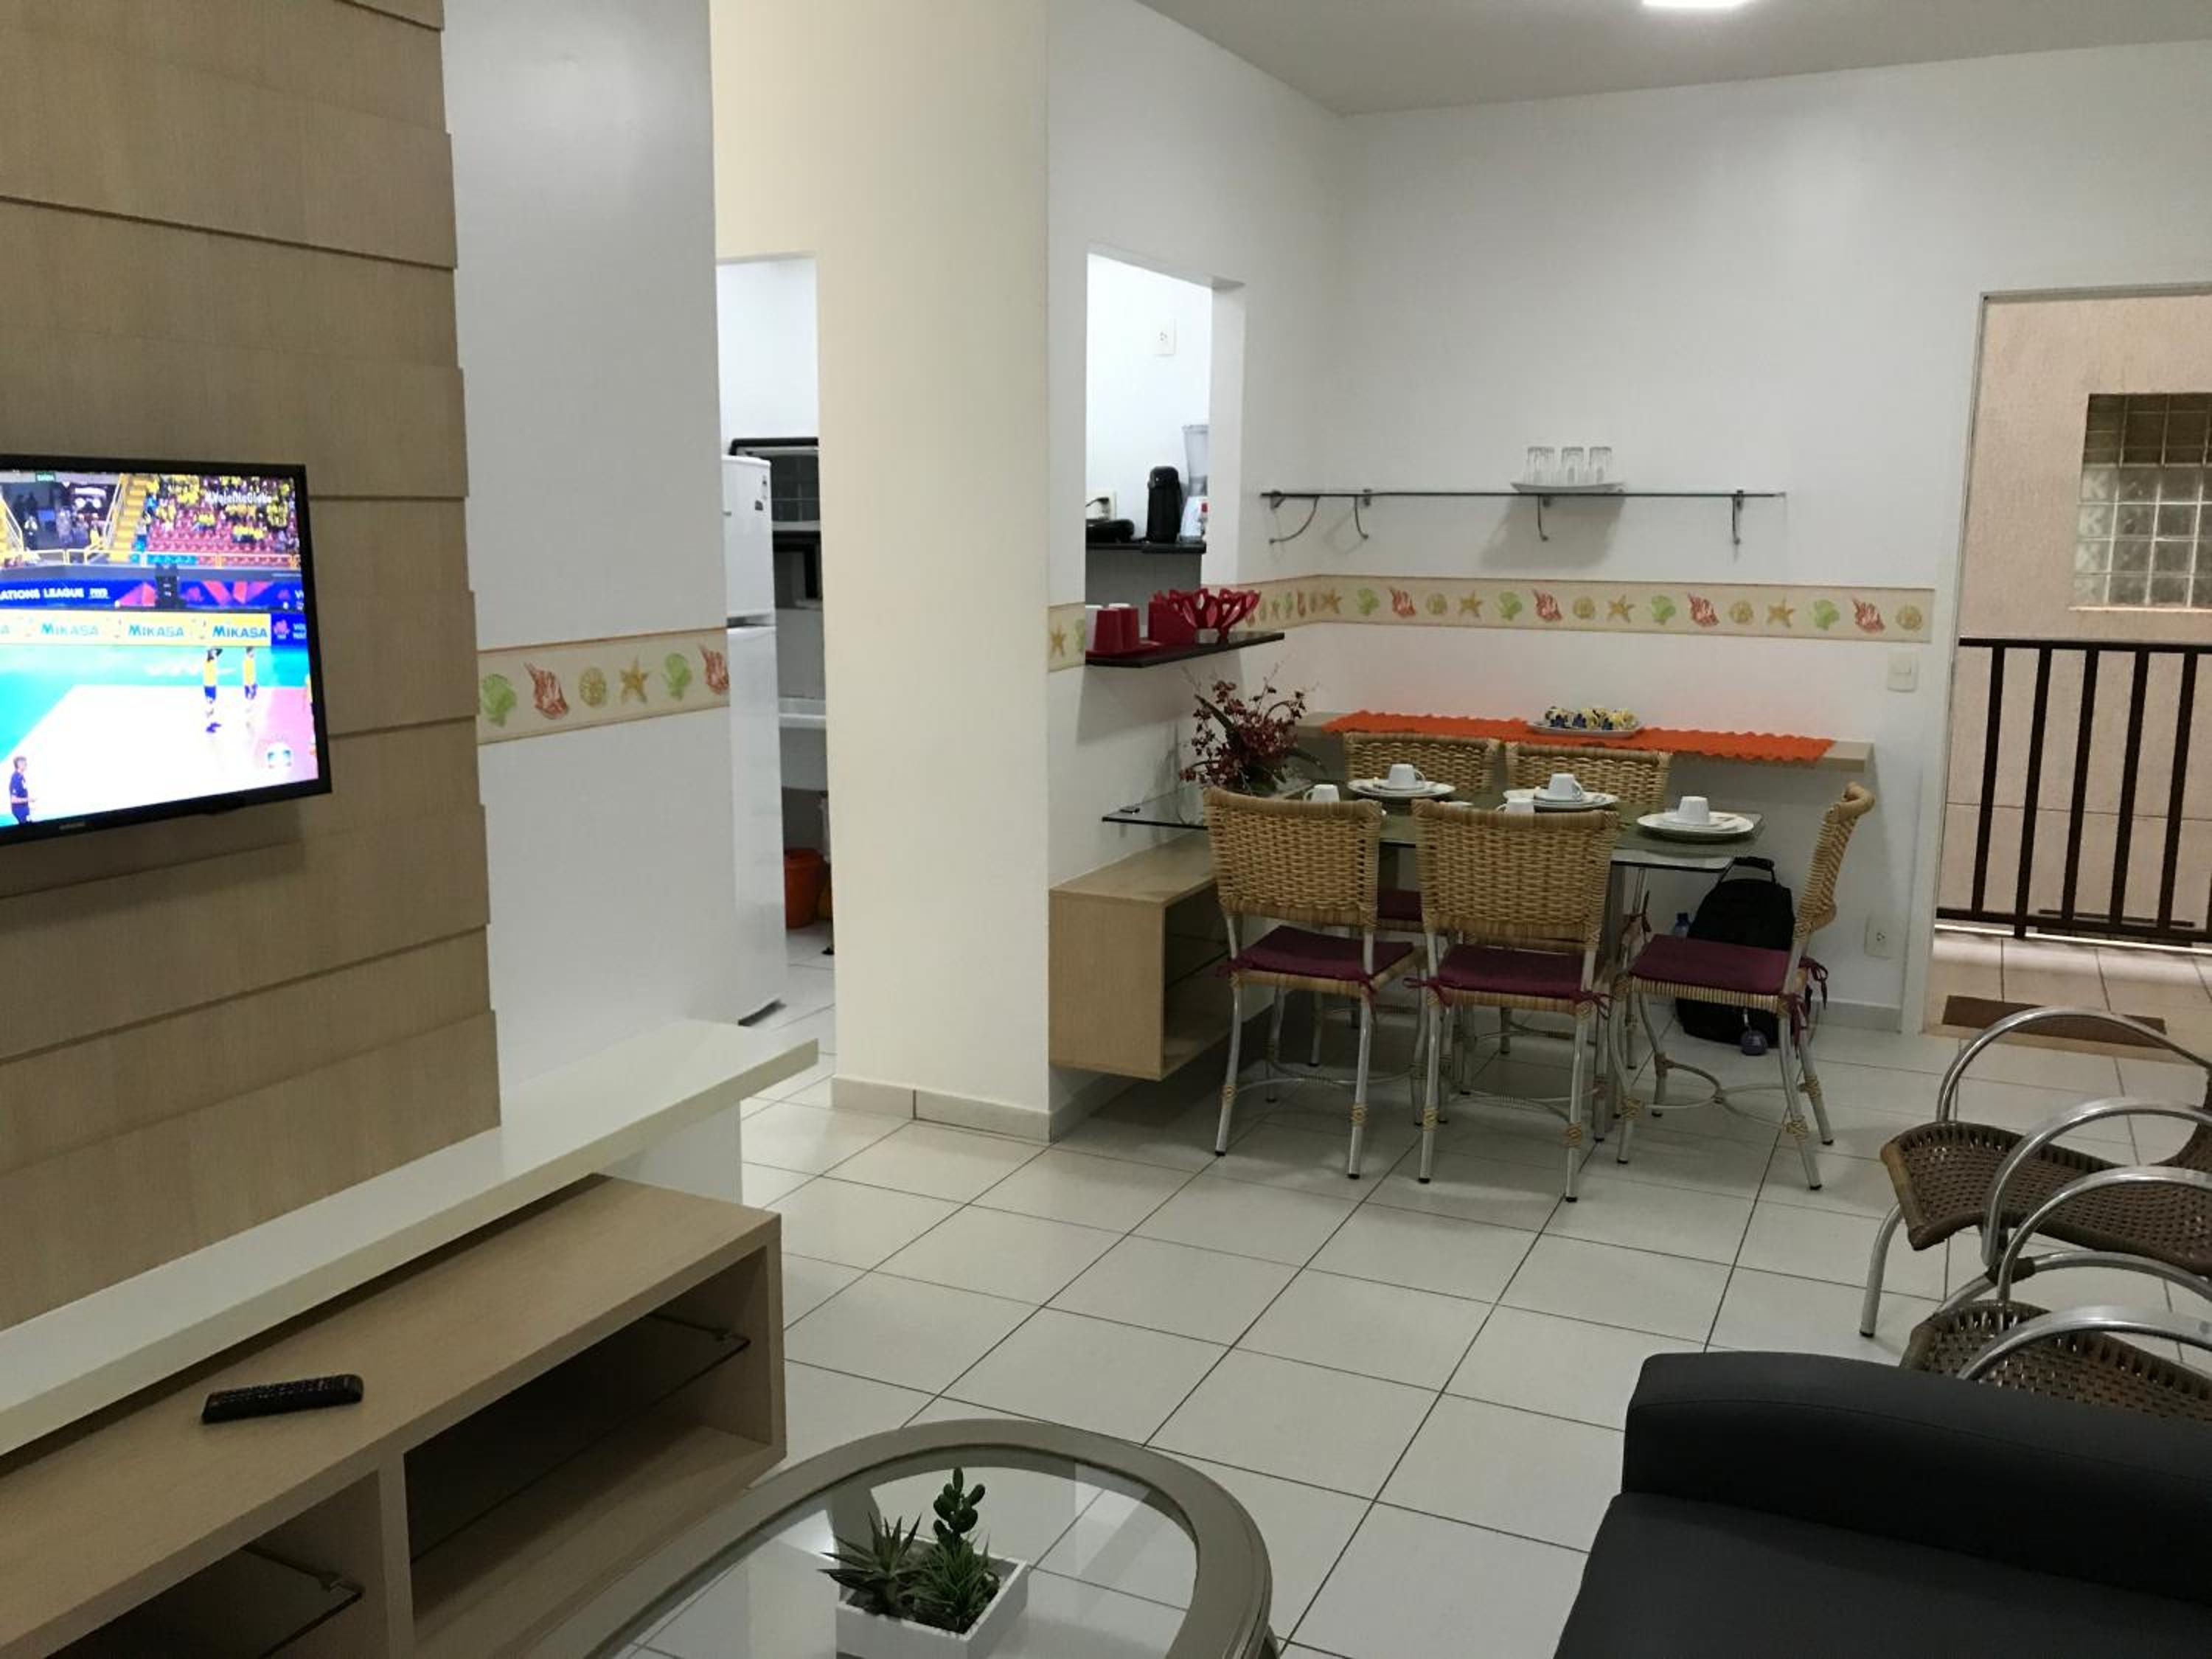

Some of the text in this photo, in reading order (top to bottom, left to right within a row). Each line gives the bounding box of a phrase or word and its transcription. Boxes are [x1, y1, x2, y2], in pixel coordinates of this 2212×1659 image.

[44, 588, 84, 597] LEAGUE
[42, 623, 98, 636] MIKASA
[128, 625, 184, 638] MIKASA
[212, 625, 268, 639] MIKASA
